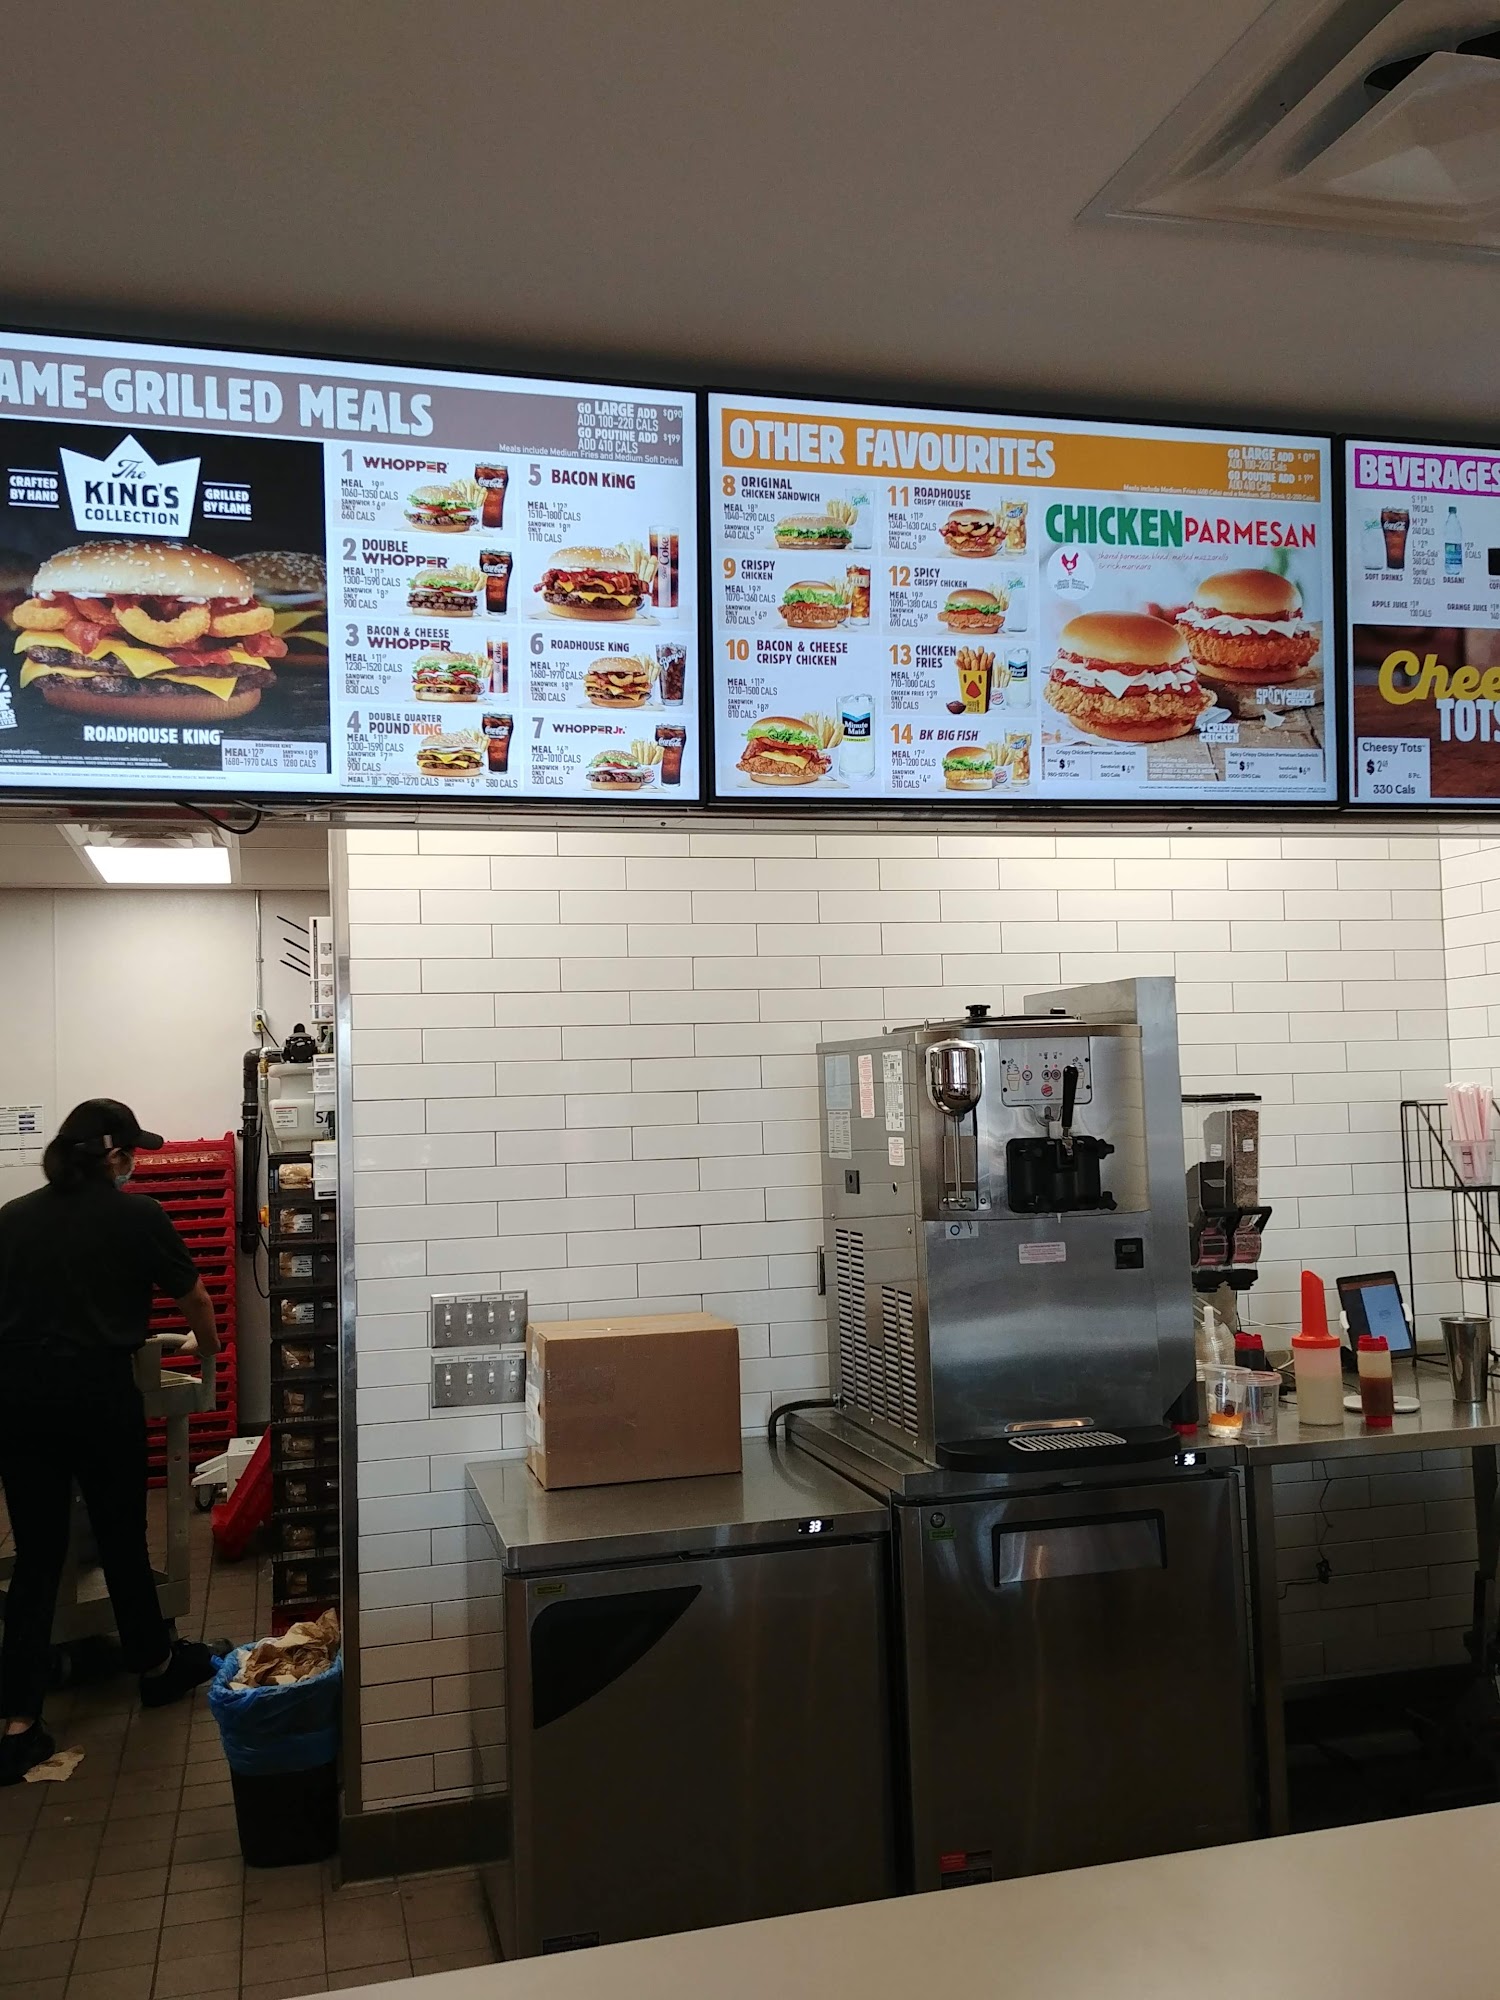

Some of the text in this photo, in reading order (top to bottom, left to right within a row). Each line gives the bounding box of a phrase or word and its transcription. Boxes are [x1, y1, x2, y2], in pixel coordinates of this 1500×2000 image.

[299, 382, 433, 437] MEALS
[577, 401, 657, 419] GO LARGE ADD
[578, 414, 658, 431] ADD 100-220 CALS
[578, 428, 657, 443] GO POUTINE ADD
[578, 438, 638, 453] ADD 410 CALS
[730, 417, 1055, 478] OTHER FAVOURITES
[499, 443, 520, 453] Meals
[523, 446, 548, 455] include
[550, 448, 578, 457] Medium
[581, 450, 598, 458] Fries
[615, 454, 643, 462] Medium
[645, 455, 658, 463] Soft
[1228, 447, 1294, 462] GO LARGE ADD
[342, 449, 447, 473] 1 WHOPPER
[112, 459, 146, 480] The
[528, 464, 635, 489] 5 BACON KING
[1360, 454, 1500, 492] BEVERAGES
[9, 475, 58, 489] CRAFTED
[341, 479, 363, 488] MEAL
[1228, 471, 1295, 484] GO POUTINE ADD
[722, 475, 792, 496] 8 ORIGINAL
[9, 489, 58, 503] BY HAND
[84, 480, 179, 508] KING'S
[205, 489, 249, 502] GRILLED
[341, 488, 398, 500] 1060-1350 CALS
[741, 489, 820, 502] CHICKEN SANDWICH
[888, 486, 971, 507] 11 ROADHOUSE
[204, 501, 251, 515] BY FLAME
[528, 501, 548, 509] MEAL
[724, 503, 743, 511] MEAL
[85, 509, 179, 526] COLLECTION
[341, 512, 375, 521] 660 CALS
[528, 510, 581, 521] 1510-1800 CALS
[888, 513, 907, 521] MEAL
[1046, 504, 1316, 548] CHICKEN PARMESAN
[528, 533, 562, 543] 1110 CALS
[343, 538, 408, 561] 2 DOUBLE
[660, 537, 669, 565] Coke
[362, 553, 448, 569] WHOPPER
[343, 567, 365, 576] MEAL
[723, 558, 775, 579] 9 CRISPY
[344, 576, 400, 587] 1300-1590 CALS
[742, 572, 772, 580] CHICKEN
[888, 566, 940, 586] 12 SPICY
[941, 580, 967, 588] CHICKEN
[346, 624, 449, 646] 3 BACON & CHEESE
[368, 637, 451, 650] WHOPPER
[530, 633, 629, 655] 6 ROADHOUSE KING
[725, 639, 848, 661] 10 BACON & CHEESE
[345, 654, 367, 662] MEAL
[757, 654, 837, 665] CRISPY CHICKEN
[889, 644, 956, 665] 13 CHICKEN
[530, 662, 550, 670] MEAL
[916, 658, 942, 668] FRIES
[1378, 650, 1500, 705] Chee
[728, 686, 777, 695] 1210-1500 CALS
[347, 711, 441, 732] 4 DOUBLE QUARTER
[369, 722, 441, 735] POUND KING
[532, 717, 544, 738] 7
[552, 724, 612, 734] WHOPPER
[84, 725, 220, 745] ROADHOUSE KING
[347, 734, 368, 742] MEAL
[890, 724, 978, 744] 14 BK BIG FISH
[225, 748, 247, 756] MEAL
[532, 745, 552, 753] MEAL
[1363, 742, 1422, 754] Cheesy Tots
[225, 758, 259, 766] 1680-1970
[283, 759, 297, 767] 1280
[532, 754, 581, 763] 720-1010 CALS
[532, 776, 563, 784] 320 CALS
[1373, 785, 1415, 794] 330 Cals
[809, 1520, 822, 1533] 33
